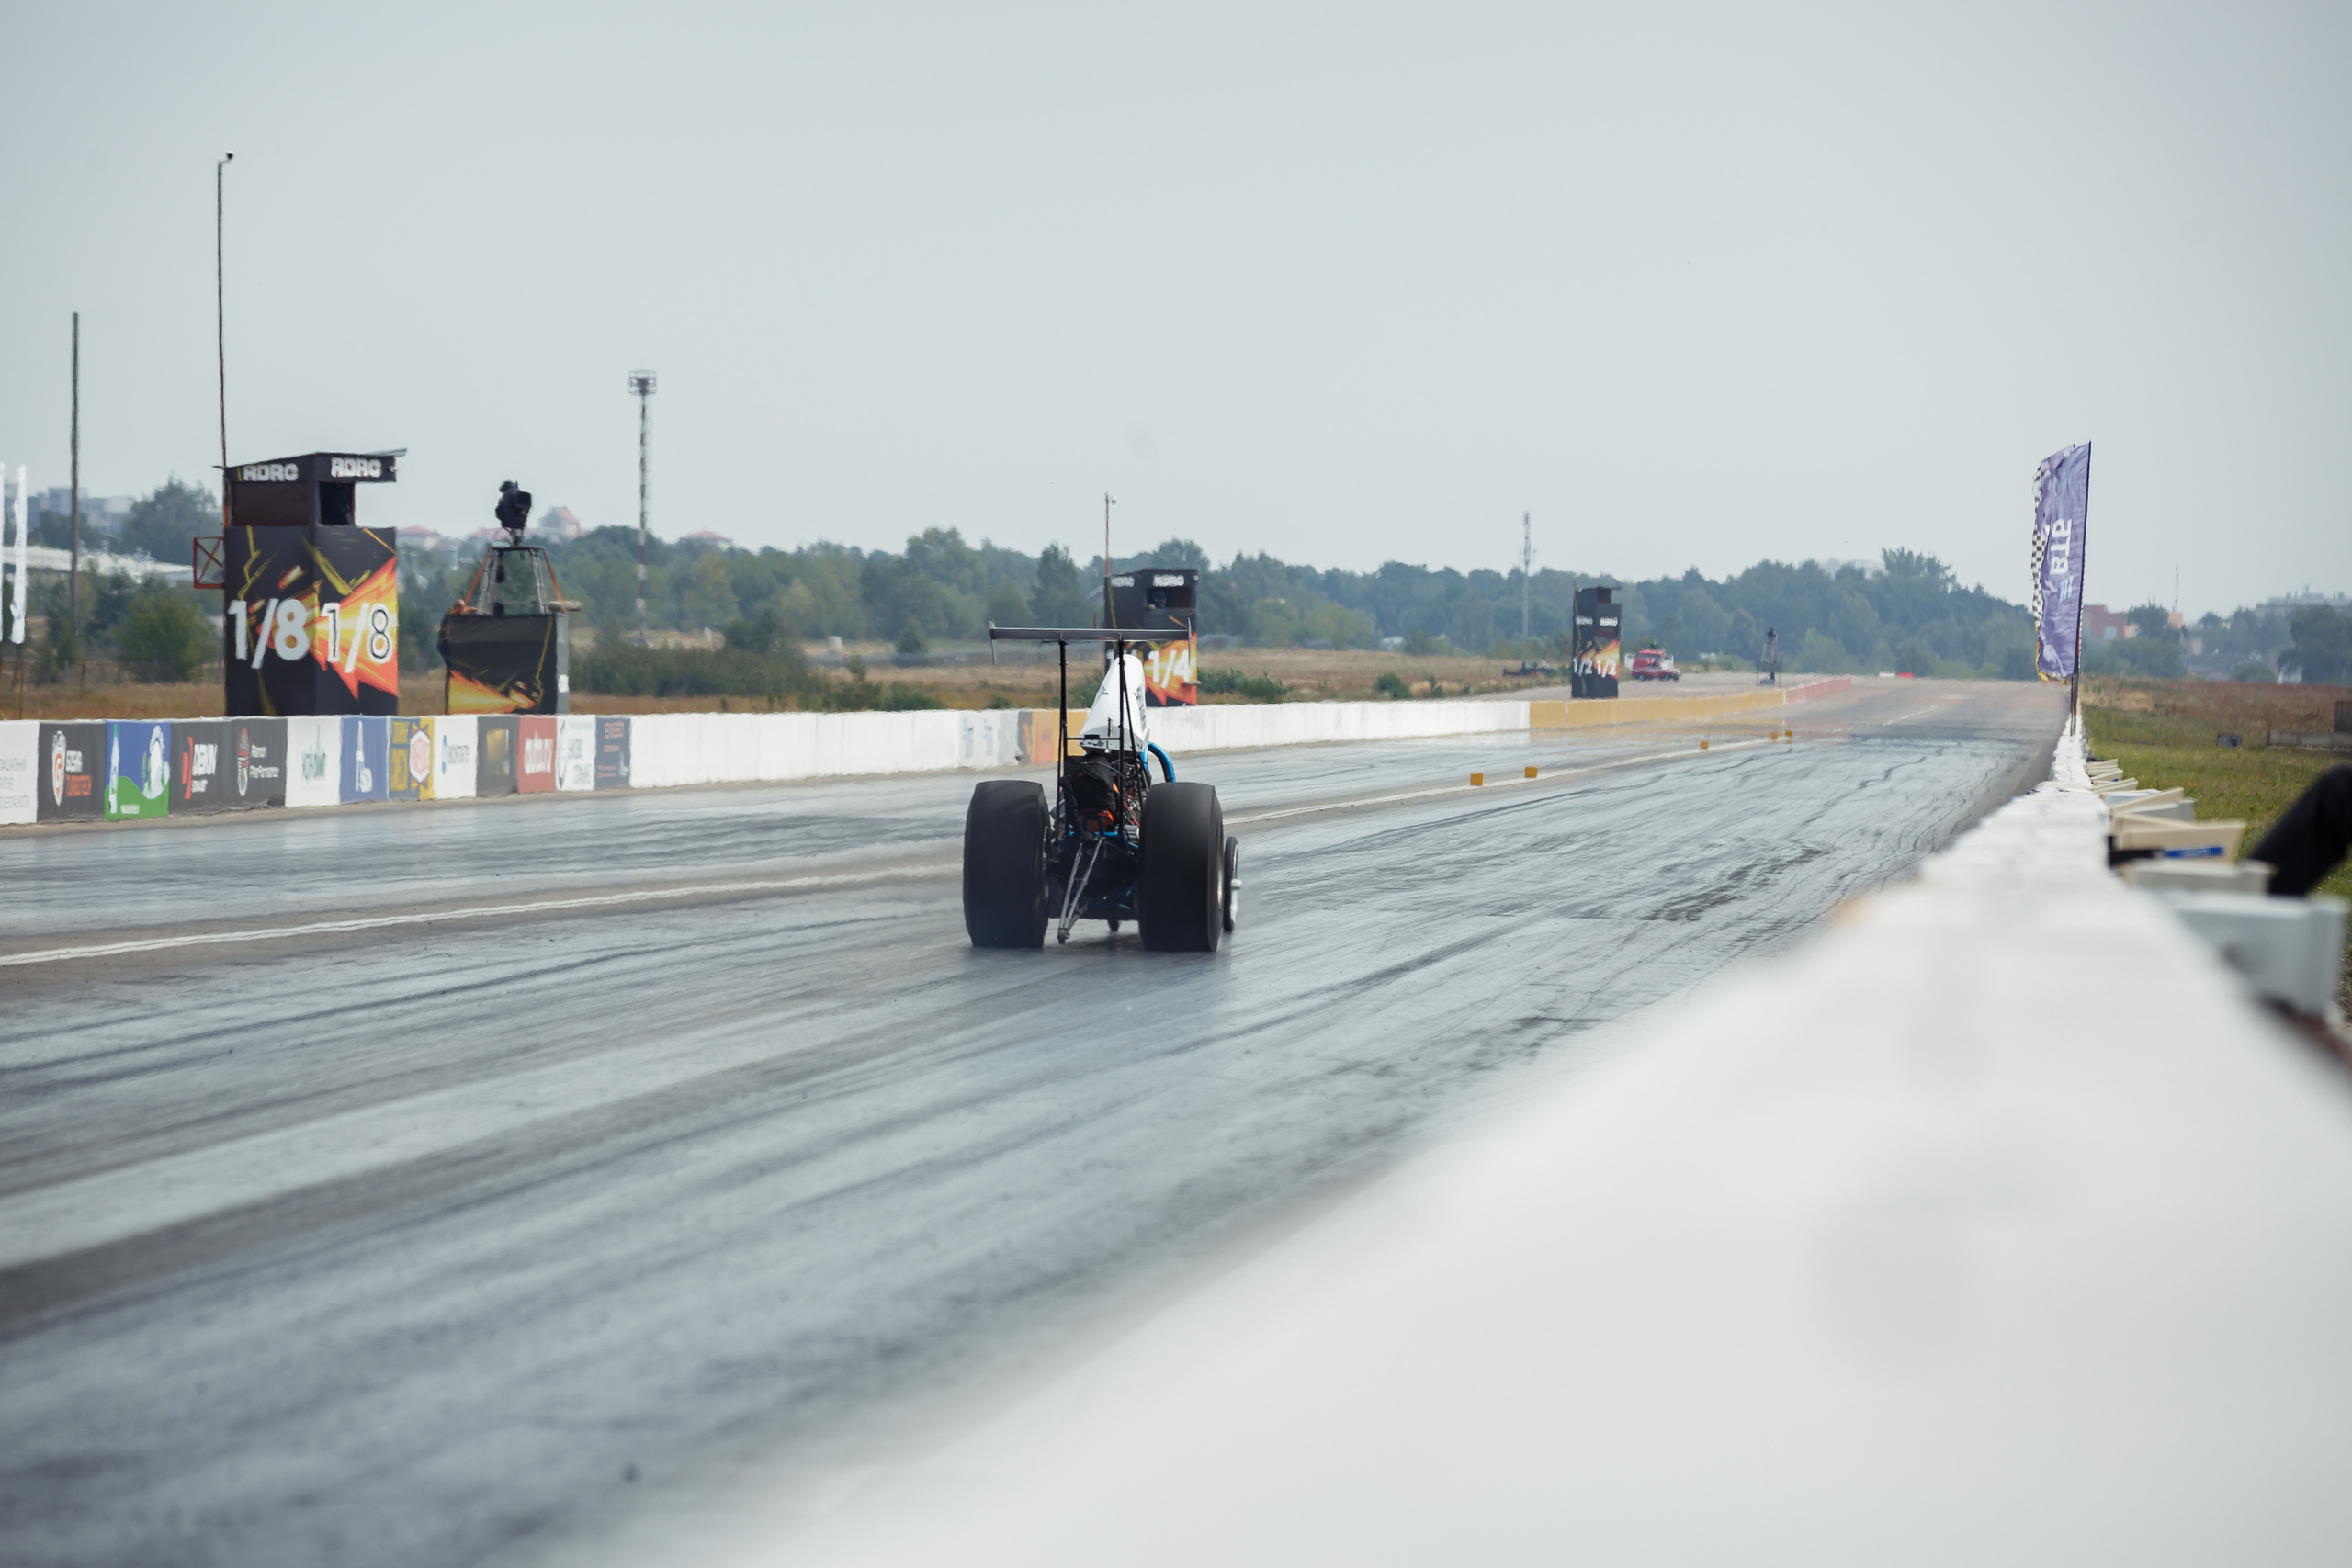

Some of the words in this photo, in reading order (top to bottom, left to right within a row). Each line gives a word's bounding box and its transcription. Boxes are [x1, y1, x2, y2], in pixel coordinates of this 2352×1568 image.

[243, 463, 299, 482] RDRC
[331, 457, 382, 478] RDRC
[227, 598, 311, 670] 1/8
[322, 602, 393, 673] 1/8
[1148, 649, 1193, 689] 1/4
[1573, 656, 1593, 677] 1/2
[1597, 659, 1617, 678] 1/2
